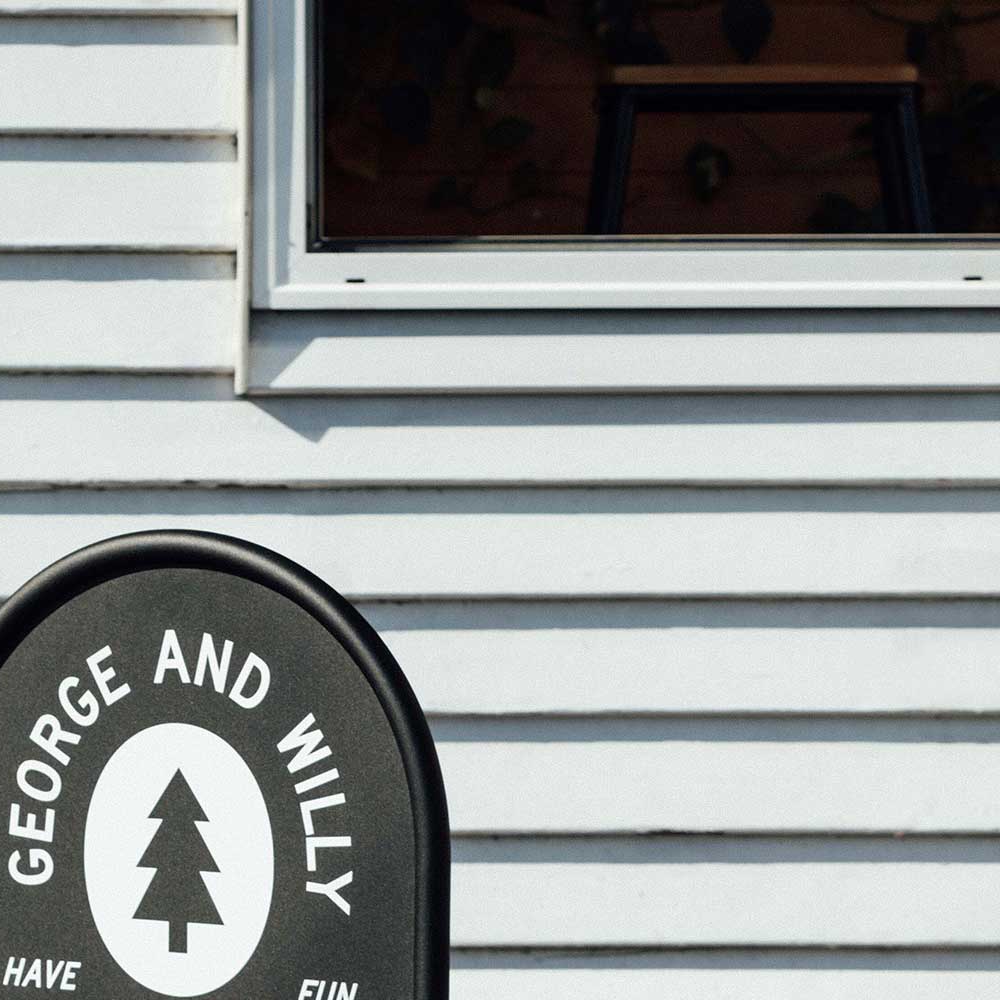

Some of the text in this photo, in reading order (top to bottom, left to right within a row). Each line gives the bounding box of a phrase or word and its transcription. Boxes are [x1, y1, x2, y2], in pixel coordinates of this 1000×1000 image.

[8, 629, 353, 916] GEORGE AND WILLY
[3, 956, 81, 991] HAVE
